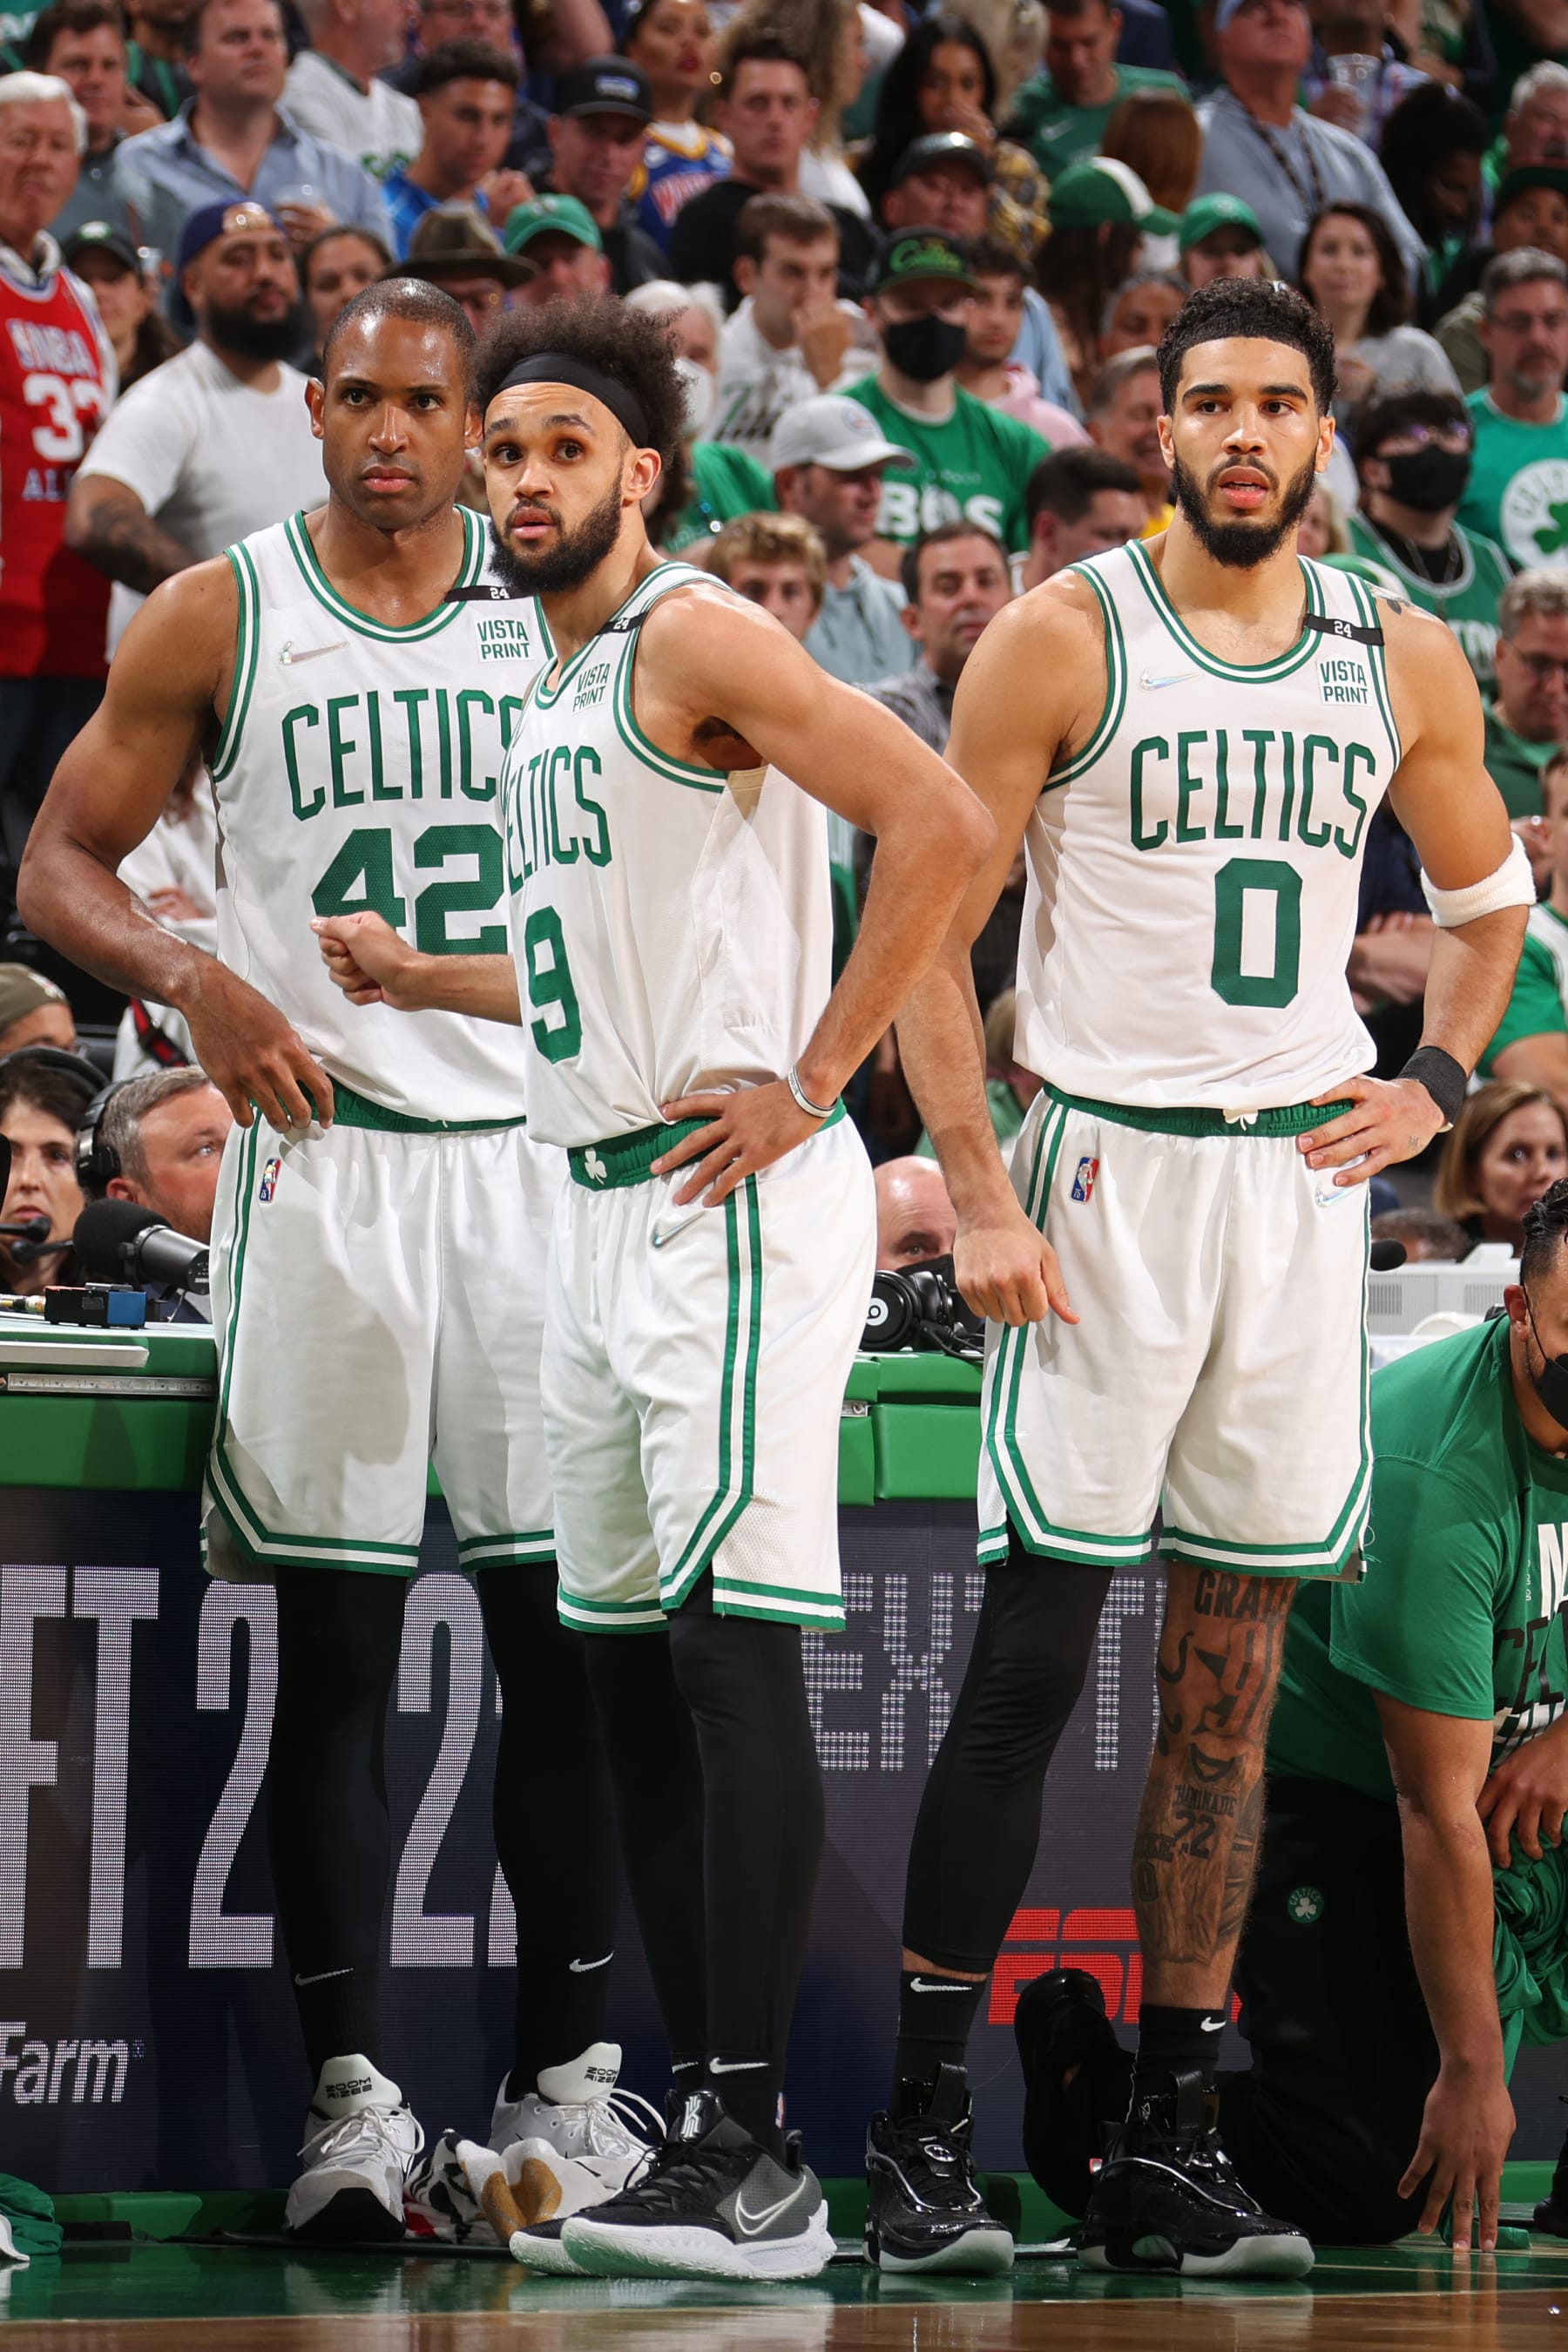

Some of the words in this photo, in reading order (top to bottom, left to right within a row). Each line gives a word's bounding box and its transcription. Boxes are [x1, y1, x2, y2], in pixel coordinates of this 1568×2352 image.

[490, 587, 510, 600] 24
[476, 618, 530, 642] VISTA
[612, 618, 630, 631] 24
[1334, 620, 1353, 639] 24
[480, 642, 531, 660] PRINT
[577, 662, 612, 693] VISTA
[1320, 660, 1368, 687] VISTA
[571, 685, 607, 713] PRINT
[1323, 686, 1369, 705] PRINT
[1130, 728, 1376, 861] CELTICS
[310, 823, 509, 956] 42
[1211, 857, 1304, 1010] 0
[524, 904, 584, 1065] 9
[0, 2021, 129, 2104] Farm
[325, 2077, 372, 2092] ZOOM
